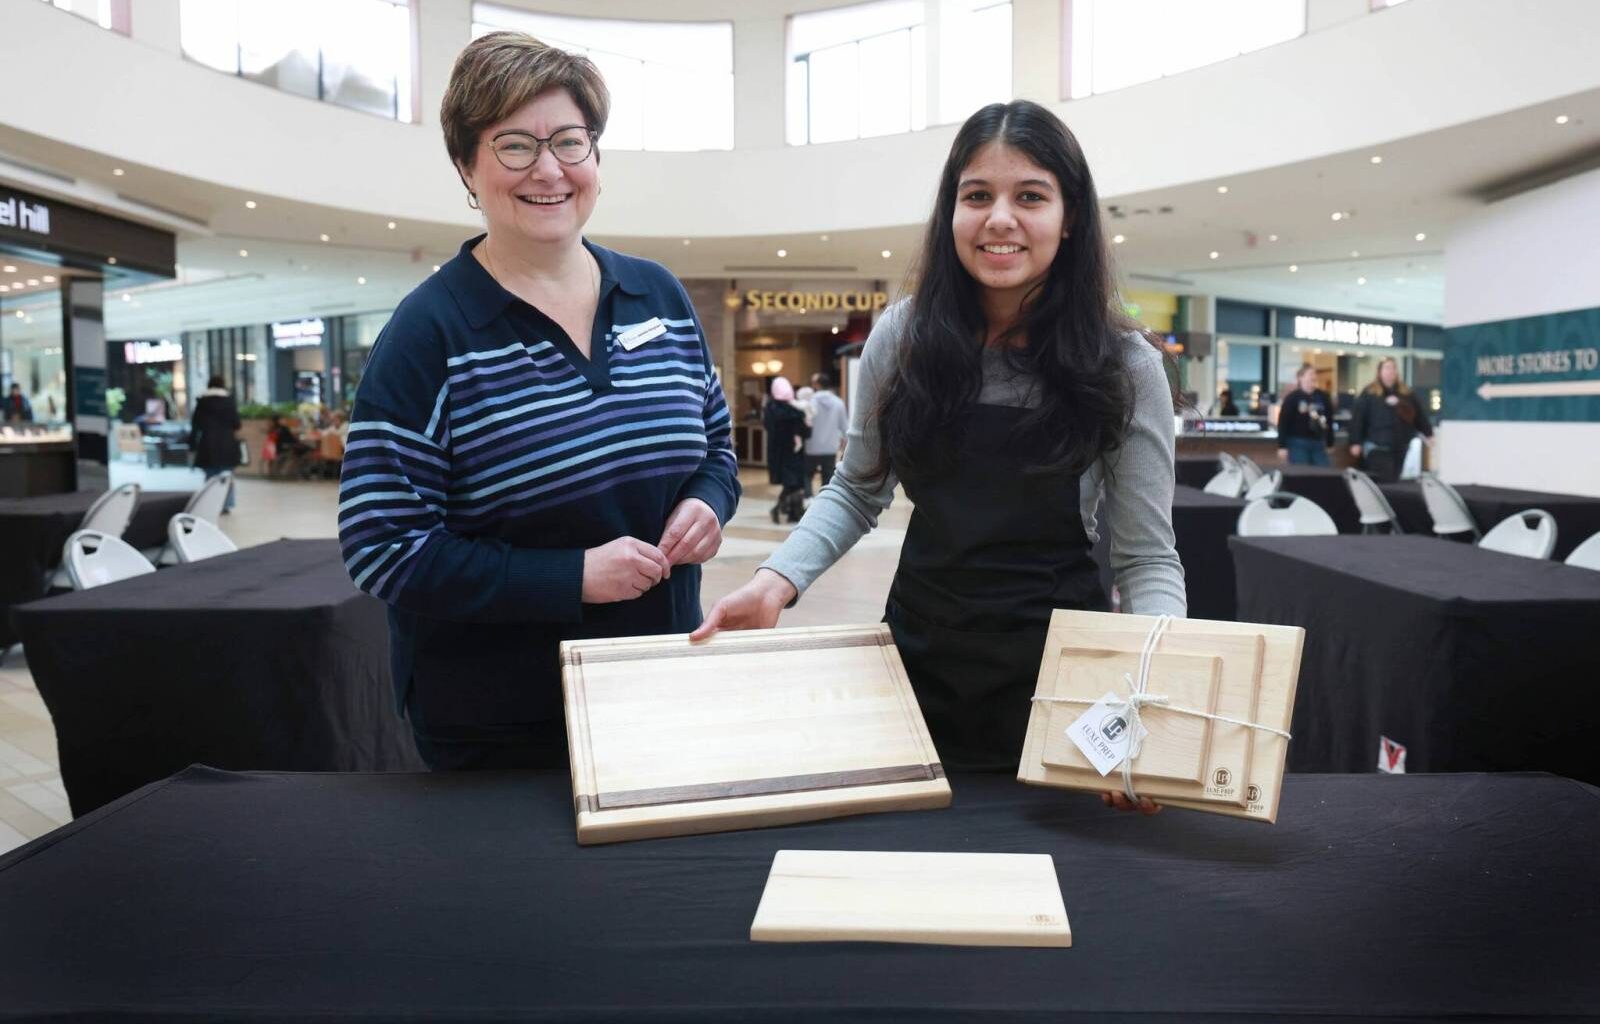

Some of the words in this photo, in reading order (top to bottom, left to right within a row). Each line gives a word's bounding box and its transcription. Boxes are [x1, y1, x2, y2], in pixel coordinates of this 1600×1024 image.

[19, 200, 50, 234] hill
[746, 289, 839, 311] SECOND
[842, 290, 888, 311] CUP
[1476, 354, 1515, 375] MORE
[1517, 350, 1571, 374] STORES
[1574, 348, 1598, 371] TO
[1082, 723, 1101, 743] LUXE
[1097, 741, 1116, 760] PREP
